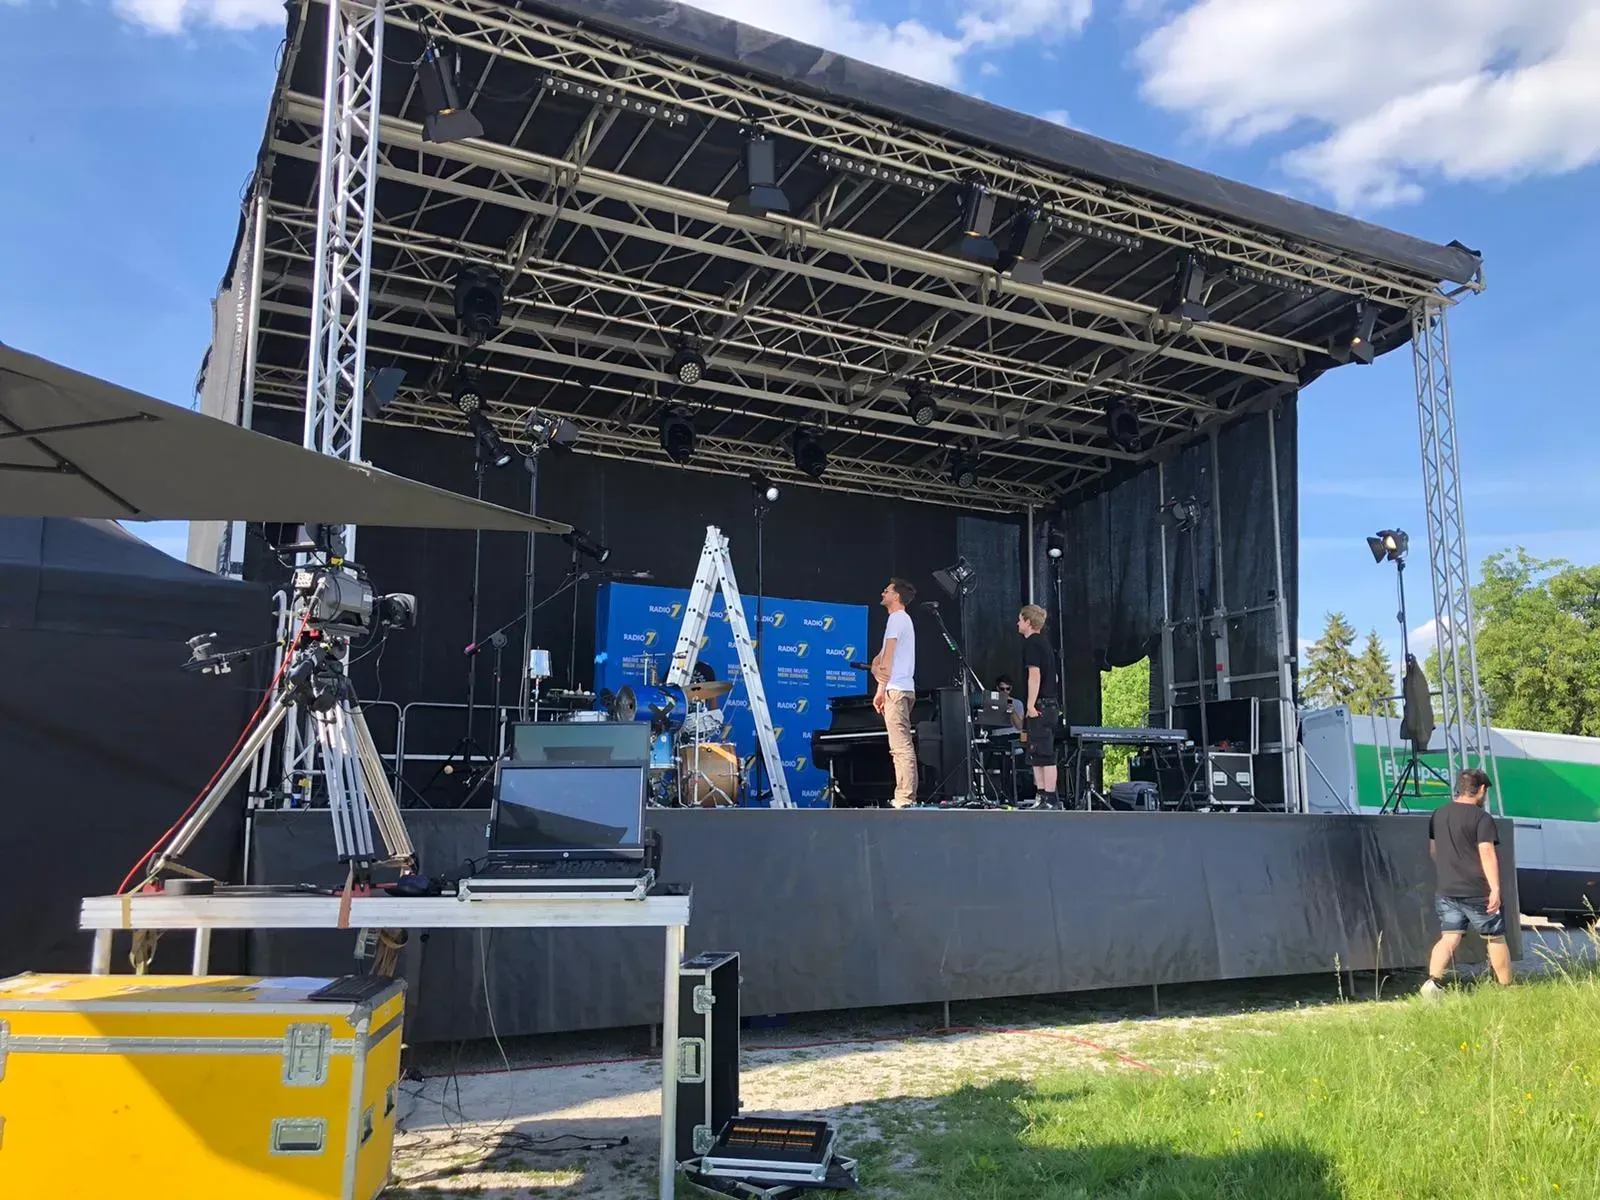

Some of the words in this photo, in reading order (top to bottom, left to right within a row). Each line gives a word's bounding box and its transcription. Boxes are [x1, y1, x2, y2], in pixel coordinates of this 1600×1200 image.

[649, 605, 671, 614] RADIO
[753, 615, 774, 623] RDIO
[803, 619, 823, 627] RADIO
[623, 633, 645, 642] RADIO
[777, 645, 798, 653] RADIO
[825, 648, 846, 656] RADIO
